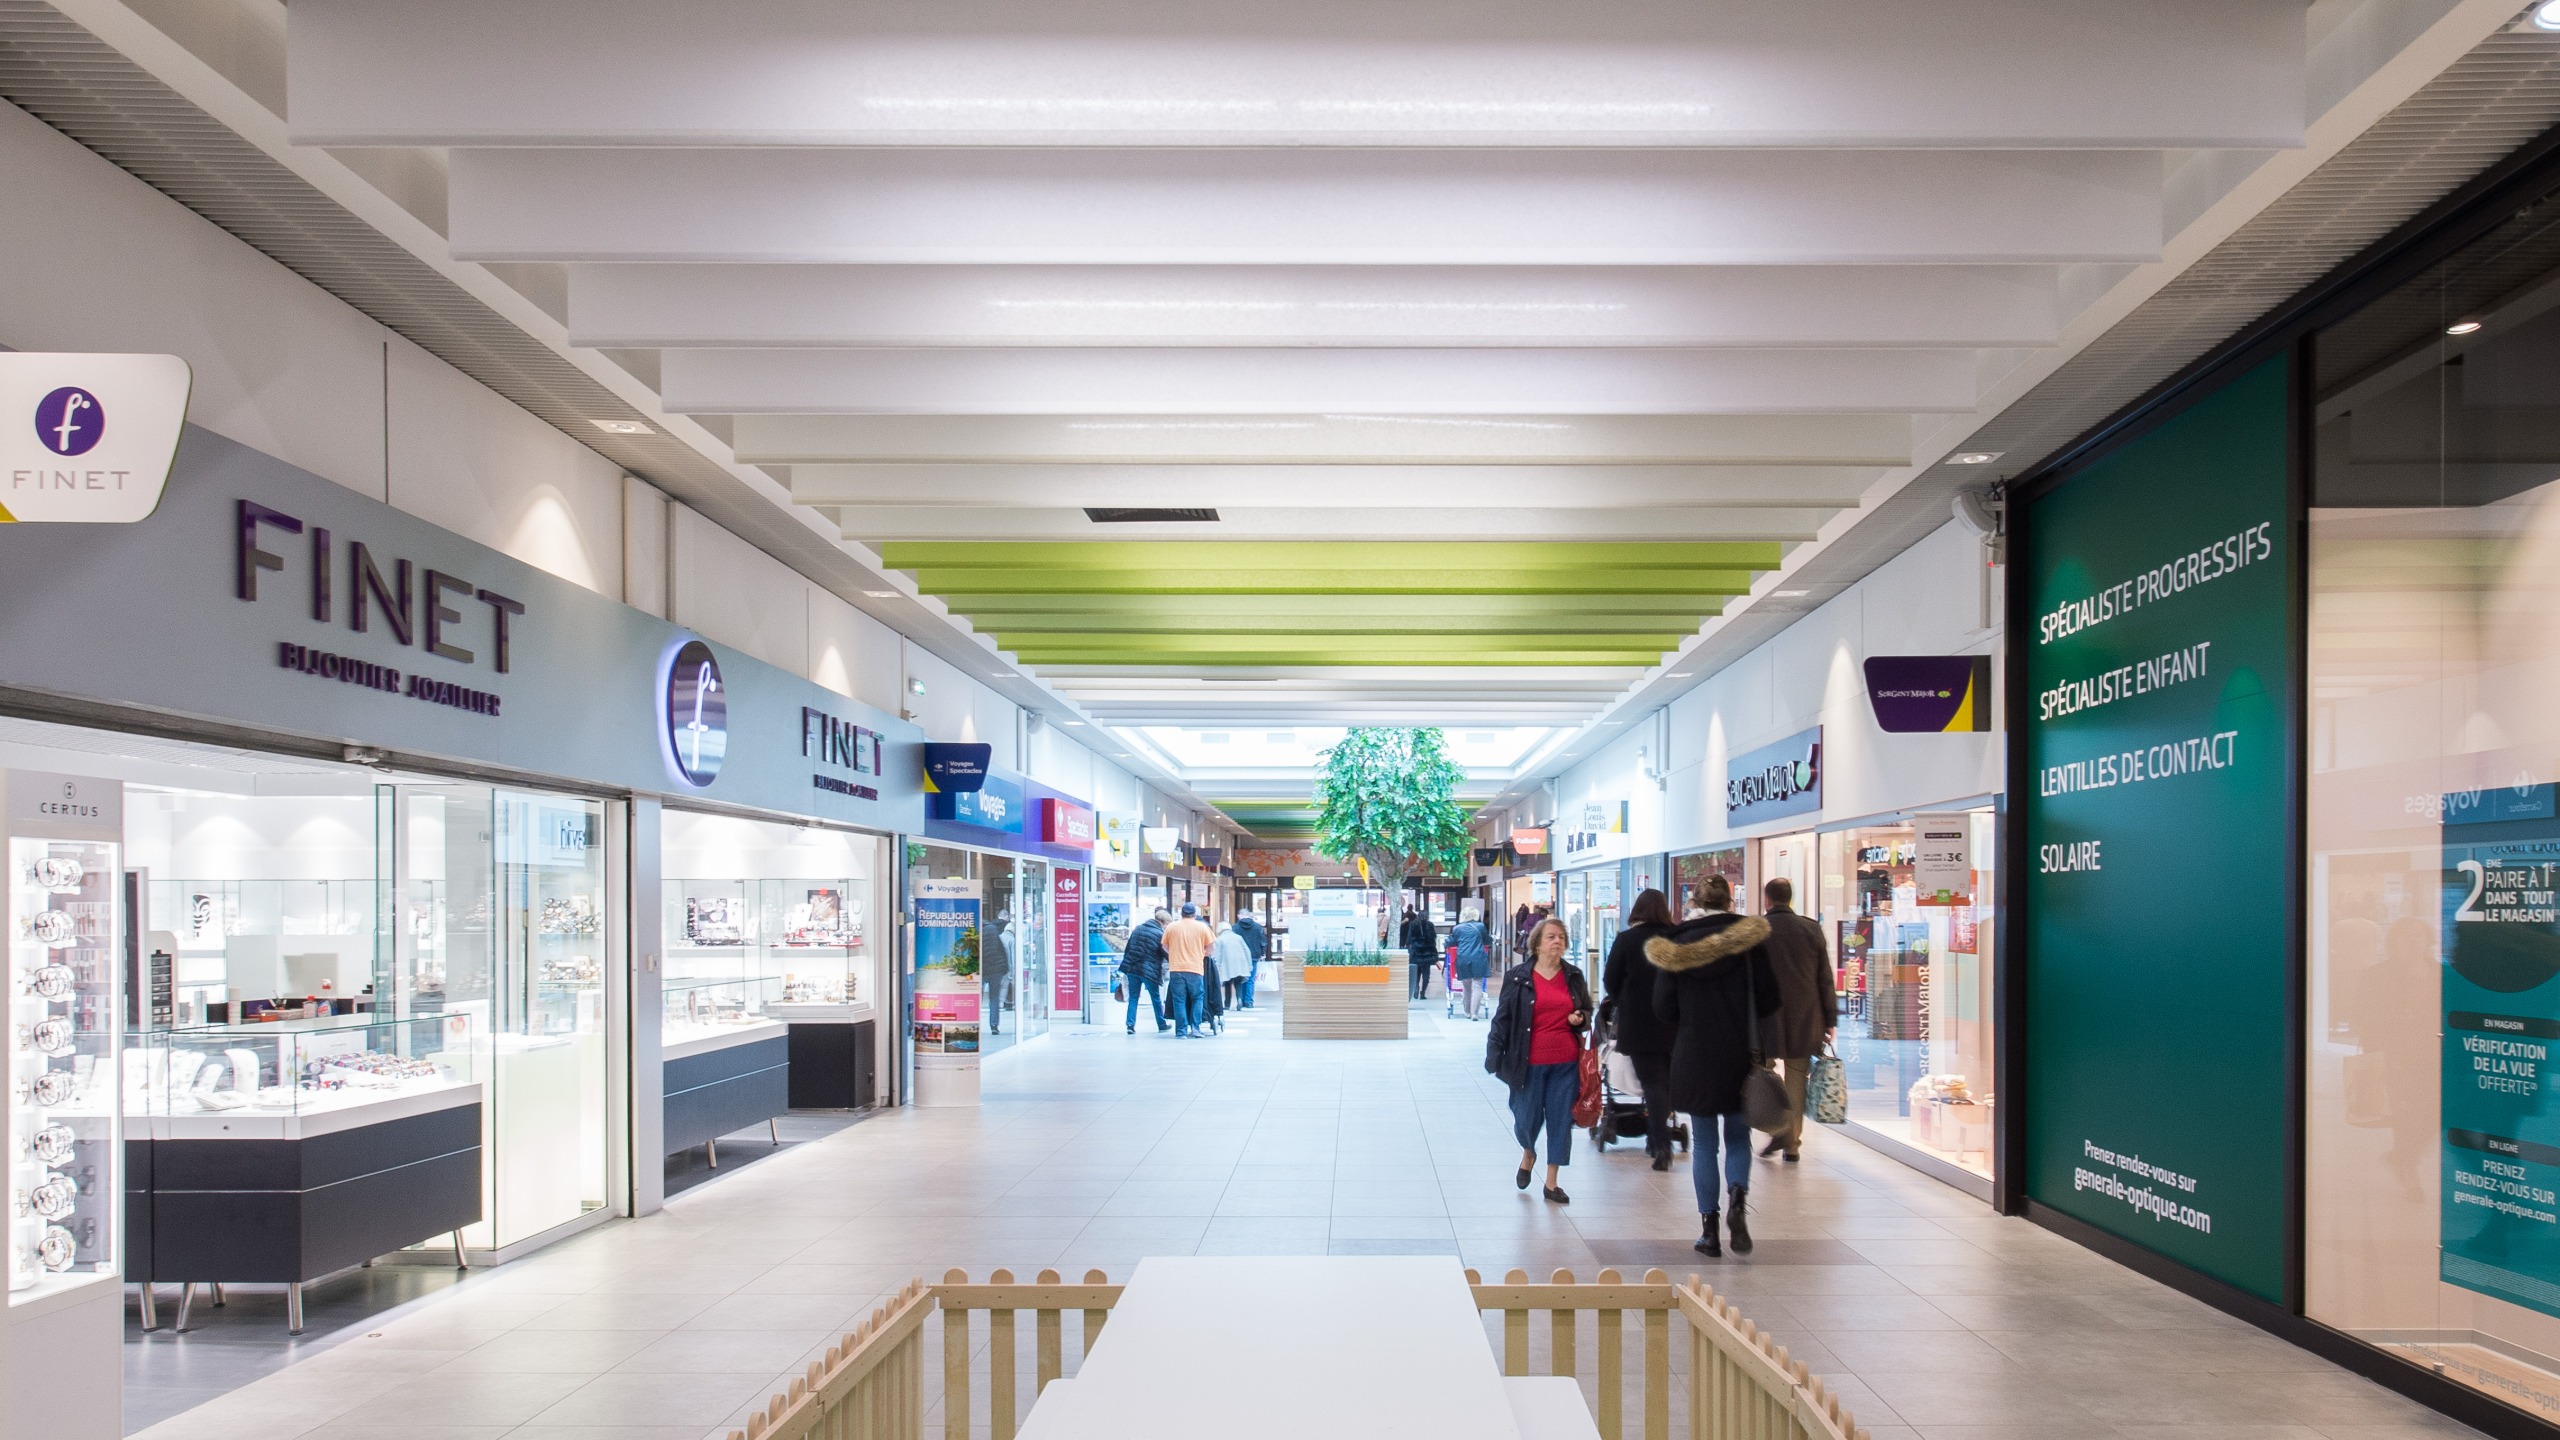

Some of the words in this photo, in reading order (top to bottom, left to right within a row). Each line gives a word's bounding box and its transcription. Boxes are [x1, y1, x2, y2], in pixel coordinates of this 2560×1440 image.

[12, 470, 131, 491] FINET
[238, 498, 525, 675] FINET
[2039, 580, 2133, 645] SPÉCIALISTE
[2136, 521, 2272, 608] PROGRESSIFS
[280, 641, 400, 693] BIJOUTIER
[404, 674, 501, 717] JOAILLIER
[2039, 666, 2133, 721] SPÉCIALISTE
[2136, 641, 2211, 695] ENFANT
[802, 706, 885, 776] FINET
[2040, 756, 2118, 797] LENTILLES
[2121, 750, 2145, 783] DE
[2147, 731, 2238, 780] CONTACT
[40, 801, 99, 818] CERTUS
[978, 788, 1006, 822] Voyages
[1584, 803, 1602, 812] Jean
[1584, 812, 1606, 821] Louis
[1584, 821, 1607, 830] David
[2039, 841, 2101, 873] SOLAIRE
[938, 885, 969, 893] Voyages
[2486, 871, 2526, 888] PAIRE
[2528, 866, 2540, 888] À
[2455, 860, 2485, 922] 2
[2486, 891, 2518, 905] DANS
[2522, 891, 2555, 905] TOUT
[918, 920, 975, 928] DOMINICAINE
[2486, 909, 2499, 922] LE
[2484, 1019, 2494, 1028] EN
[2494, 1020, 2524, 1031] MAGASIN
[2463, 1035, 2547, 1061] VÉRIFICATION
[2473, 1056, 2489, 1071] DE
[2492, 1058, 2508, 1074] LA
[2510, 1062, 2536, 1078] VUE
[2489, 1140, 2499, 1149] EN
[2499, 1141, 2519, 1153] LIGNE
[2084, 1139, 2116, 1166] Prenez
[2116, 1154, 2177, 1187] rendez-vous
[2178, 1174, 2197, 1194] sur
[2483, 1159, 2526, 1180] PRENEZ
[2455, 1170, 2530, 1199] RENDEZ-VOUS
[2531, 1188, 2556, 1205] SUR
[2074, 1167, 2211, 1234] generale-optique.com
[2454, 1191, 2557, 1224] generale-optique.com
